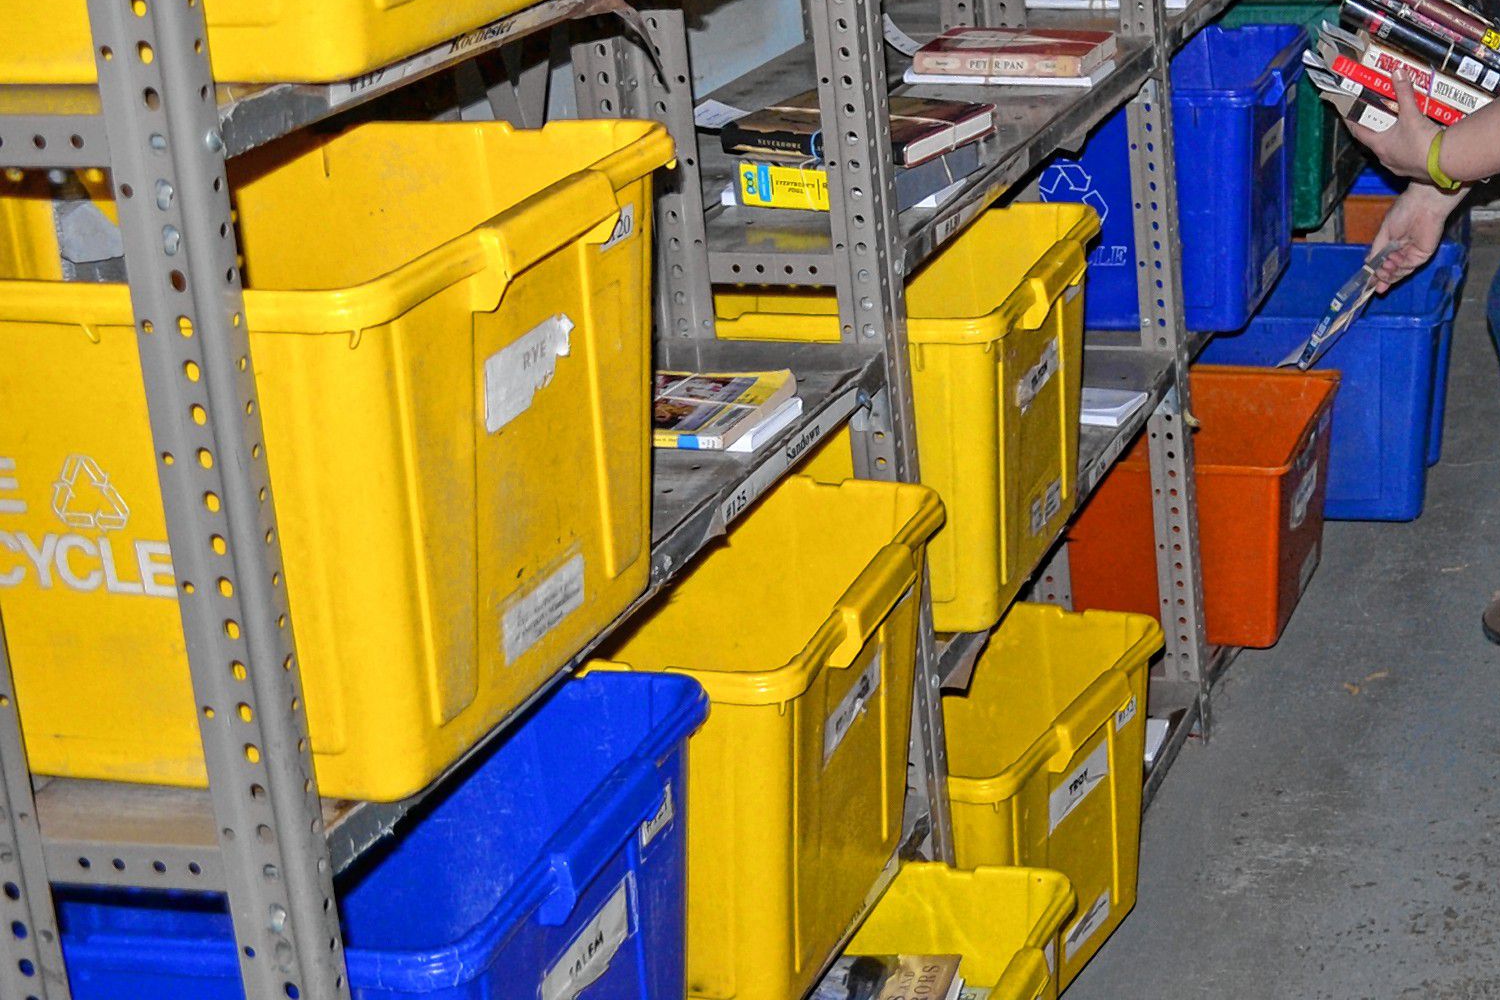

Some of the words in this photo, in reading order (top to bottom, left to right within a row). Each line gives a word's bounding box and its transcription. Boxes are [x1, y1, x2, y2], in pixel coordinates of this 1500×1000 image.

[1003, 60, 1025, 70] PAN
[523, 342, 547, 370] RYE
[725, 490, 747, 521] #125
[785, 424, 821, 466] Sandown
[1069, 768, 1088, 795] TROY
